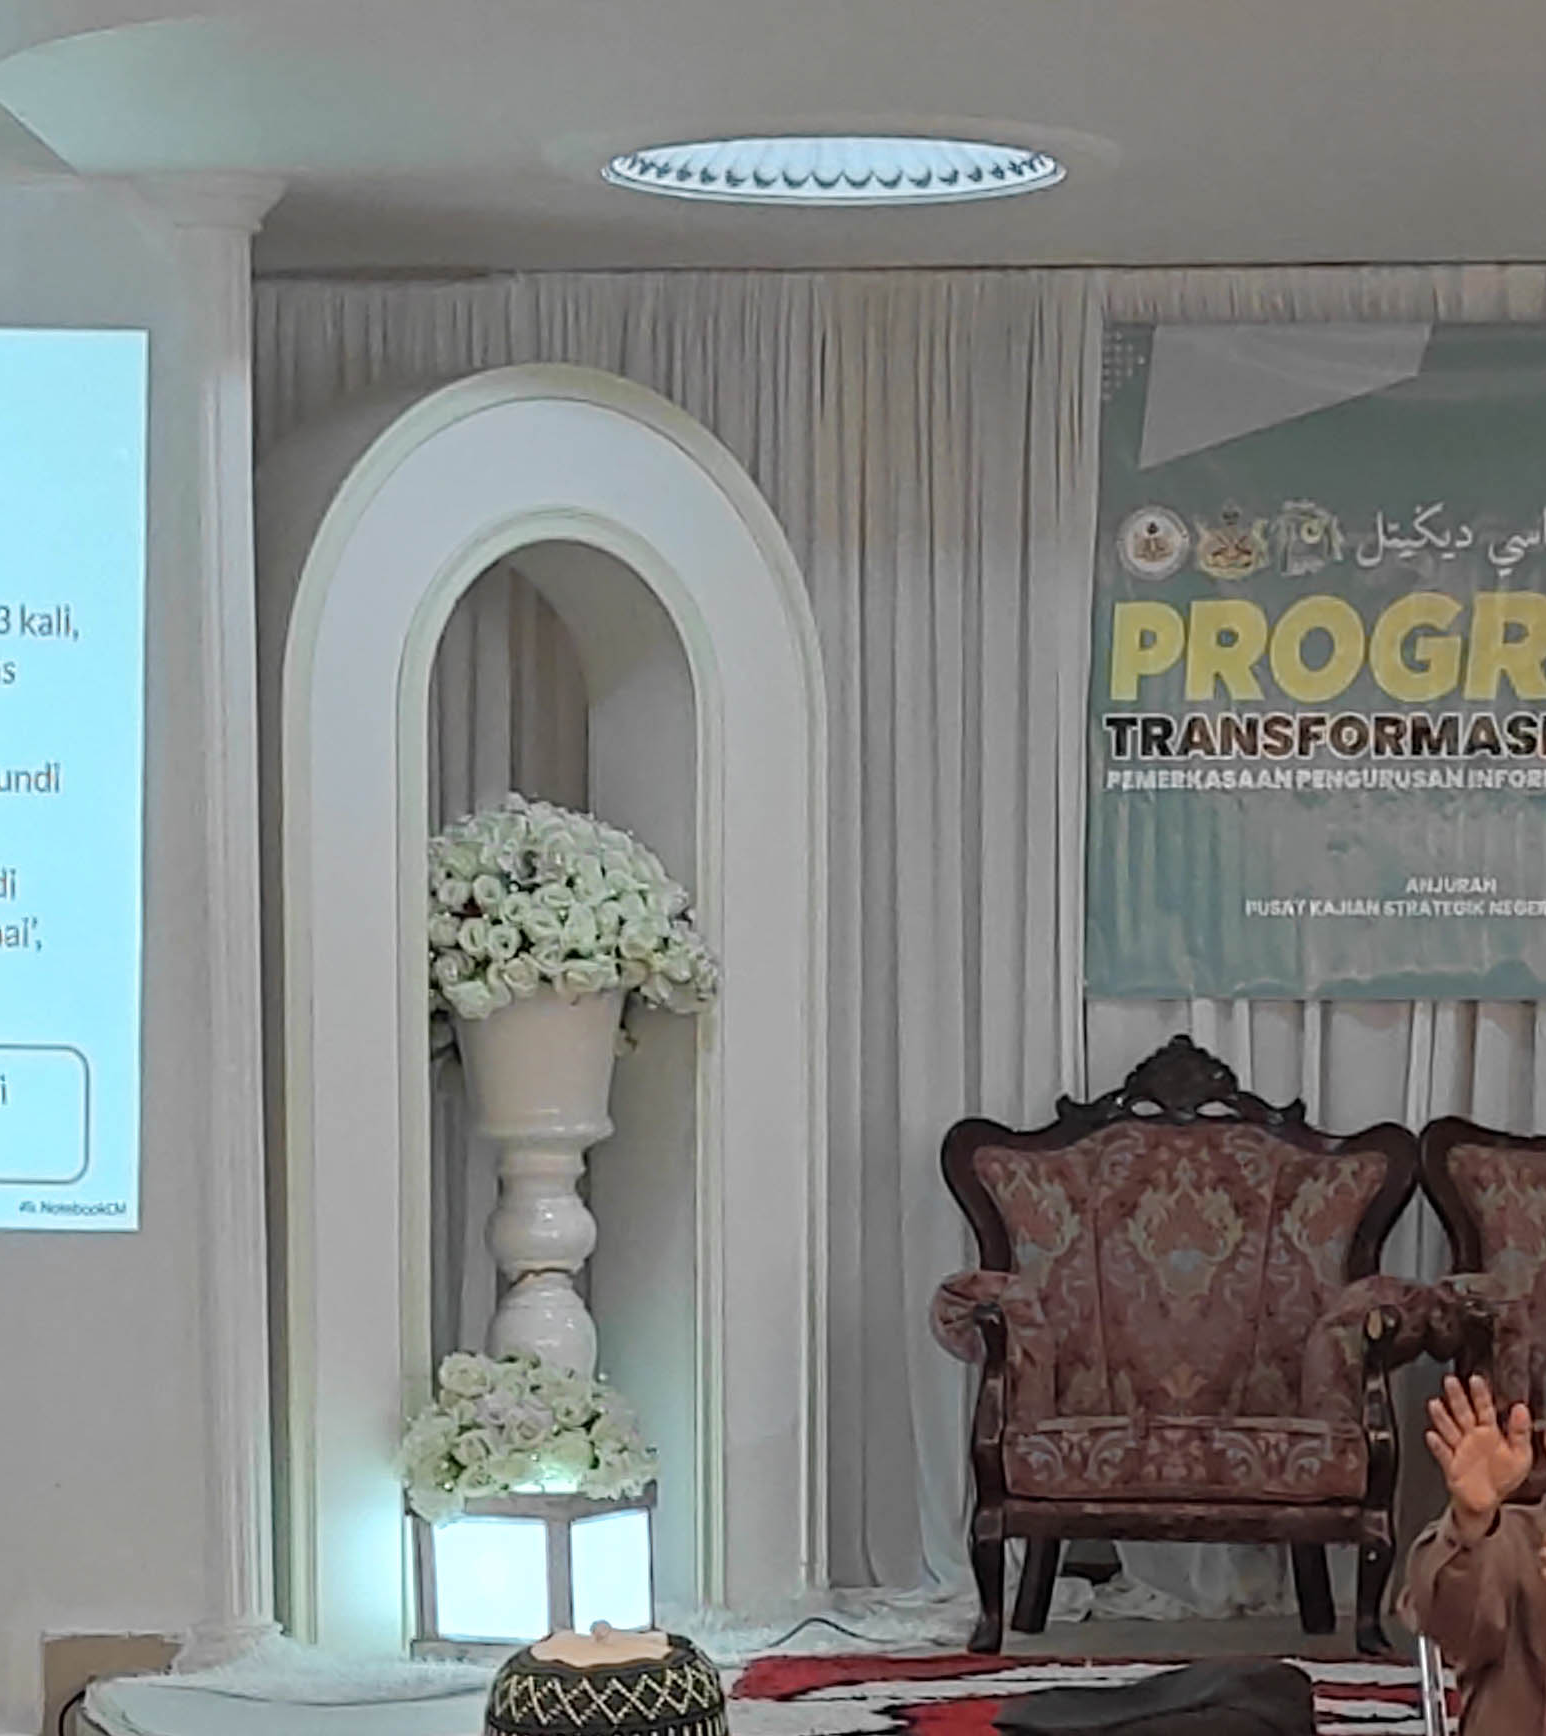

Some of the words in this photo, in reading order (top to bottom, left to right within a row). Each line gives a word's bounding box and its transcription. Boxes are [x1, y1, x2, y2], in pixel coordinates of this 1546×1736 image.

[20, 603, 80, 641] kali,
[1106, 768, 1295, 791] PEMERKASAAN
[1296, 767, 1464, 791] PENGURUSAN
[1405, 876, 1498, 895] ANJURAN
[1245, 898, 1305, 918] PUSAT
[1309, 898, 1381, 917] KAJIAN
[1383, 899, 1485, 917] STRATEGIK
